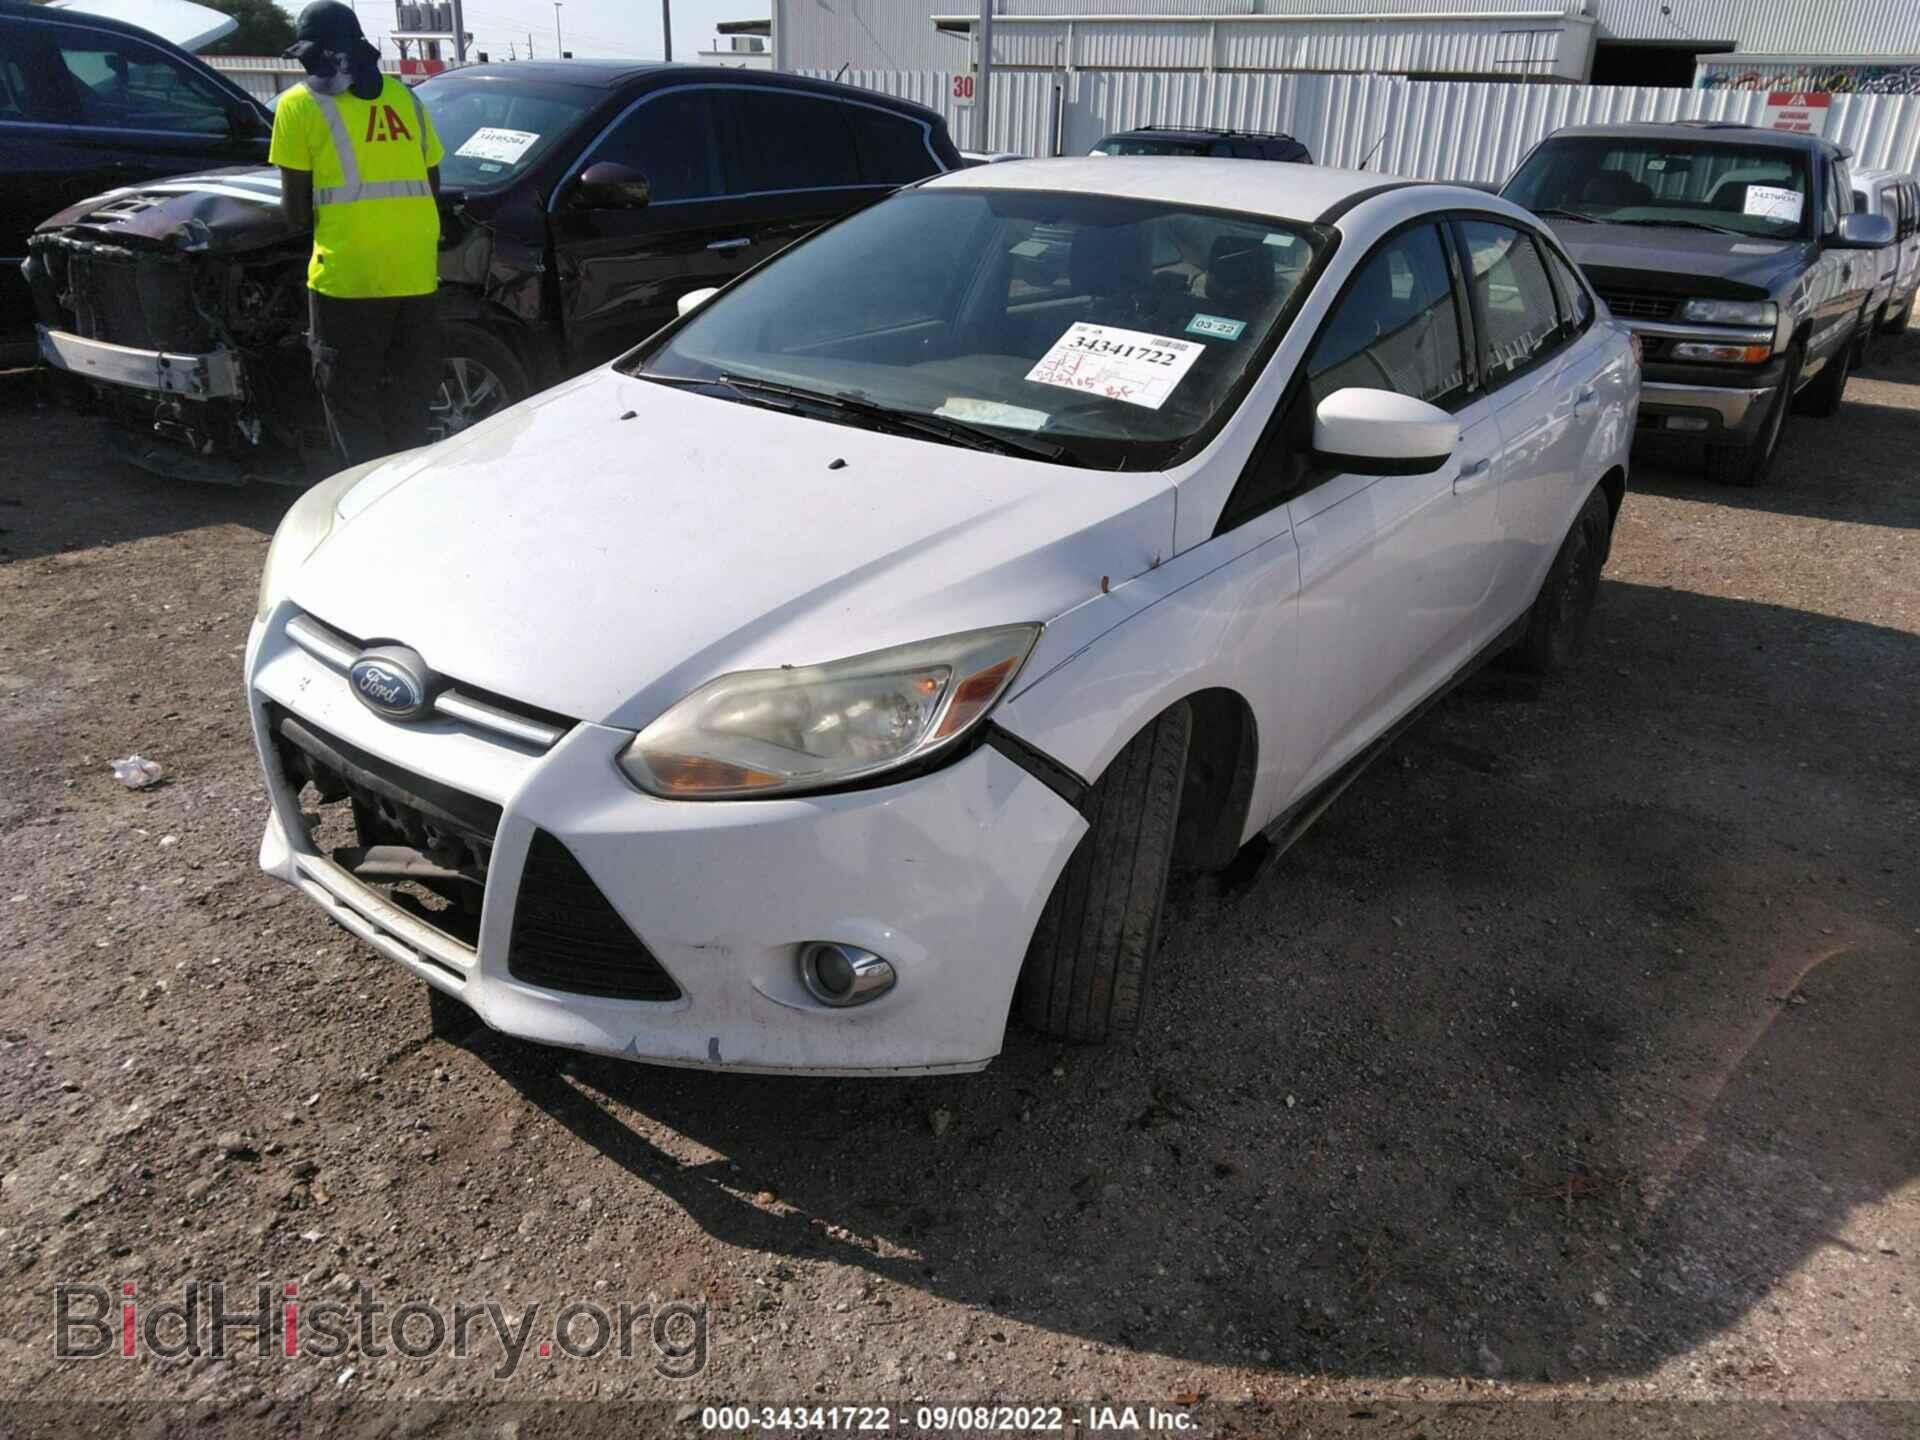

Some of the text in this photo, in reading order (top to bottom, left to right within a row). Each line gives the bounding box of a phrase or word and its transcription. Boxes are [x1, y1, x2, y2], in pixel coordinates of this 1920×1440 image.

[954, 75, 973, 97] 30
[1068, 336, 1177, 367] 34341722
[360, 667, 401, 704] Ford
